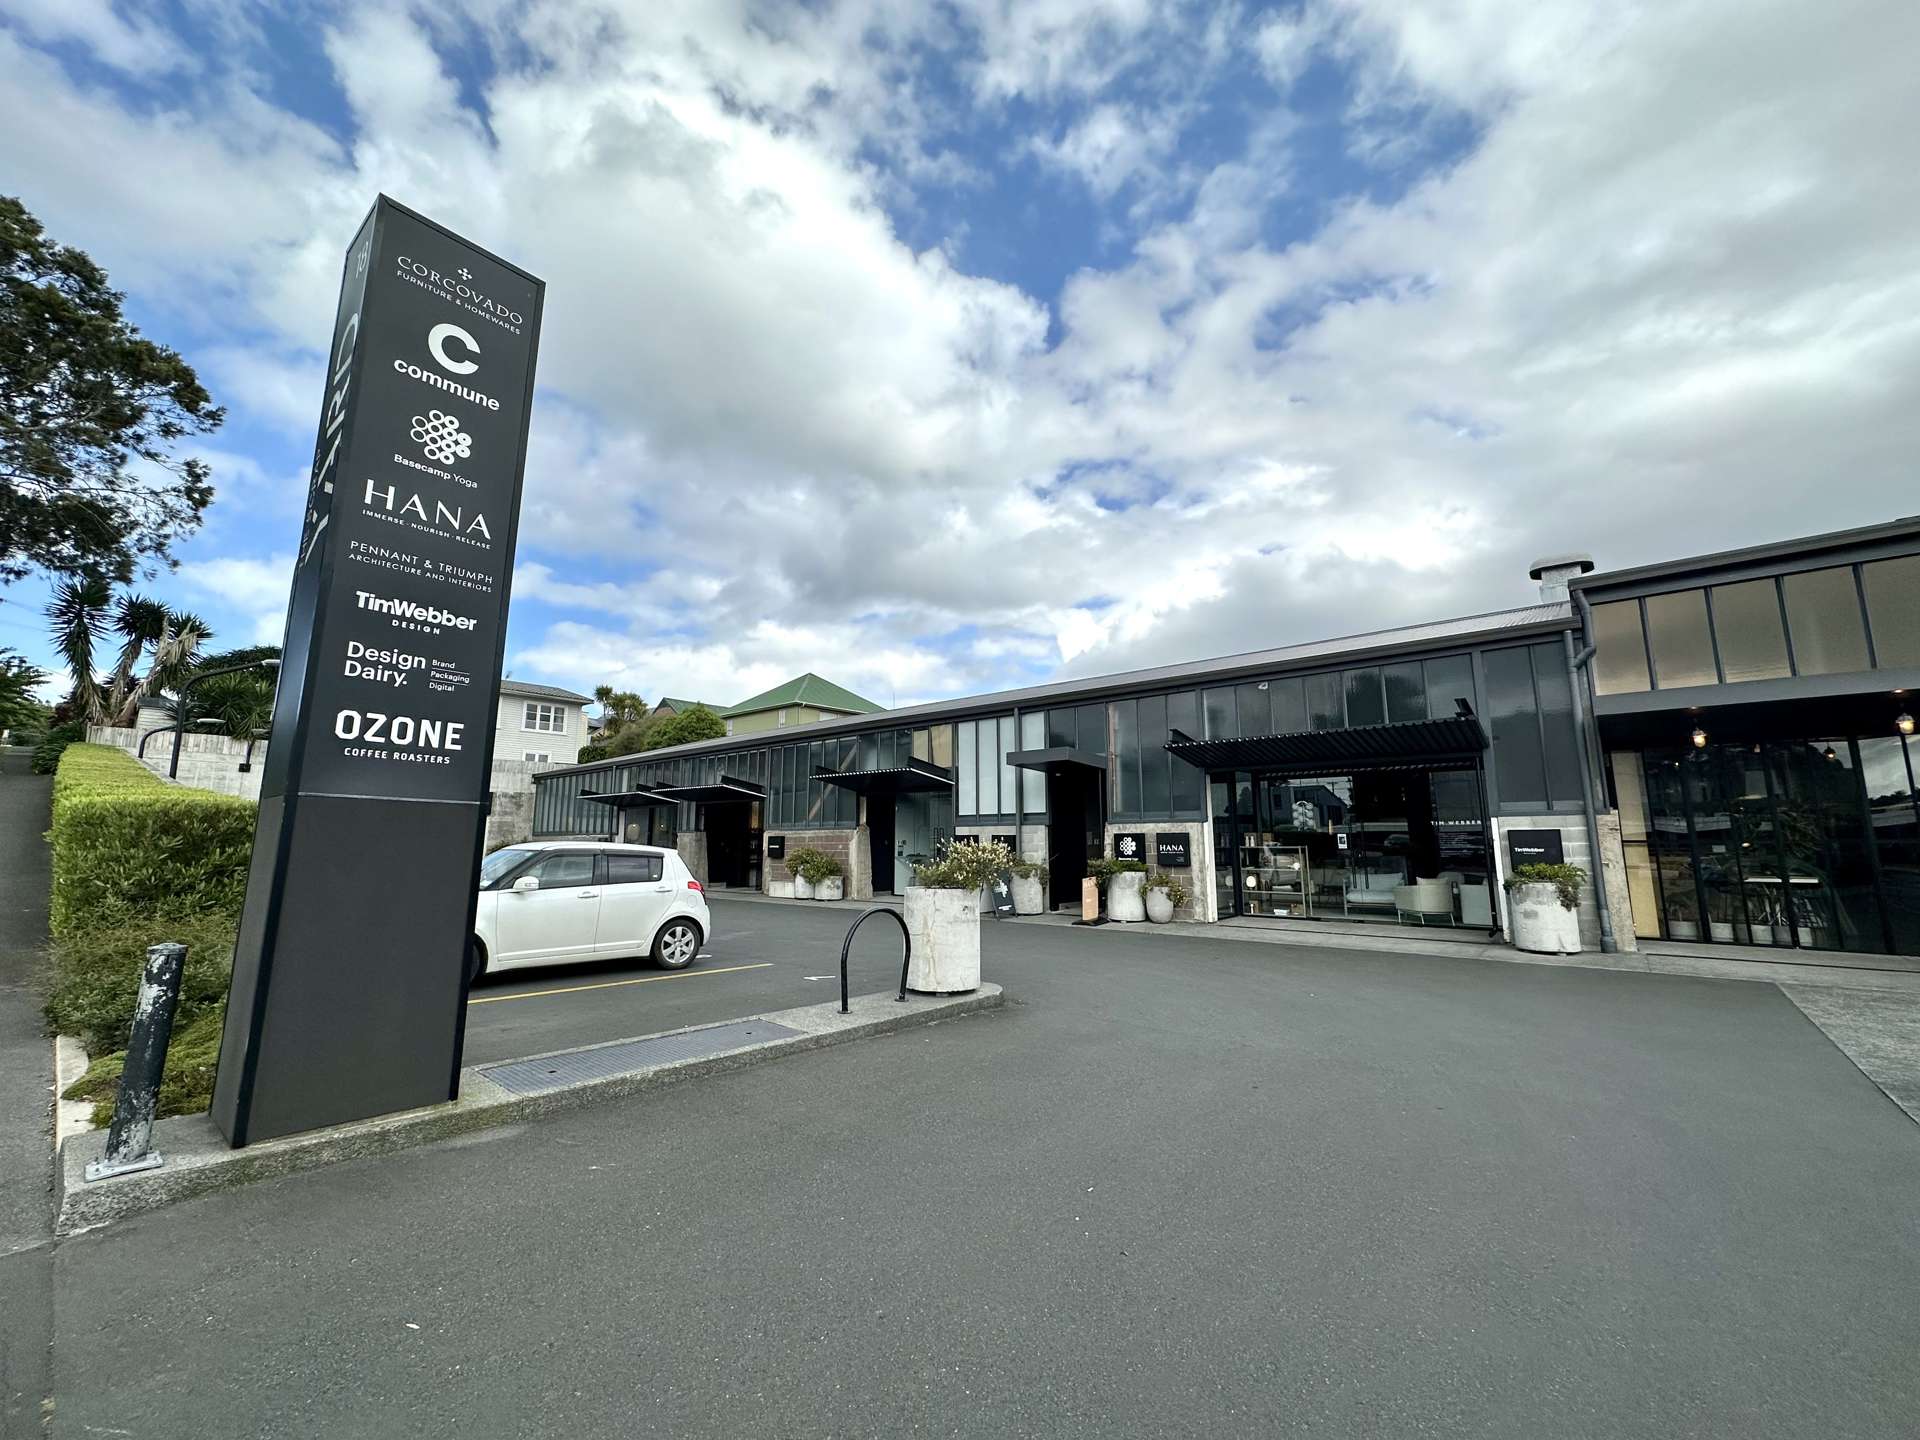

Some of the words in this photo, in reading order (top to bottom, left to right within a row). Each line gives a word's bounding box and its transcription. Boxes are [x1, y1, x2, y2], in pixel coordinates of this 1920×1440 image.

[355, 240, 369, 279] 18
[397, 256, 523, 325] CORCOVADO
[397, 270, 453, 301] FURNITURE
[464, 303, 521, 335] HOMEWARES
[427, 323, 481, 375] C
[393, 359, 500, 411] commune
[305, 312, 360, 565] YARD
[394, 453, 451, 480] Basecamp
[453, 473, 478, 489] Yoga
[362, 509, 405, 526] IMMERSE
[411, 522, 450, 538] NOURISH
[455, 535, 491, 550] RELEASE
[364, 479, 491, 540] HANA
[348, 553, 422, 576] ARCHITECTURE
[425, 571, 445, 581] AND
[448, 576, 492, 593] INTERIORS
[350, 540, 419, 566] PENNANT
[424, 559, 433, 569] &
[439, 562, 493, 584] TRIUMPH
[356, 590, 478, 631] TimWebber
[391, 619, 441, 635] DESIGN
[344, 660, 408, 688] Dairy.
[347, 640, 426, 670] Design
[432, 659, 455, 669] Brand
[429, 682, 455, 692] Digital
[430, 671, 470, 684] Packaging
[334, 709, 465, 751] OZONE
[344, 747, 388, 759] COFFEE
[393, 751, 451, 765] ROASTERS
[1159, 844, 1184, 852] HANA
